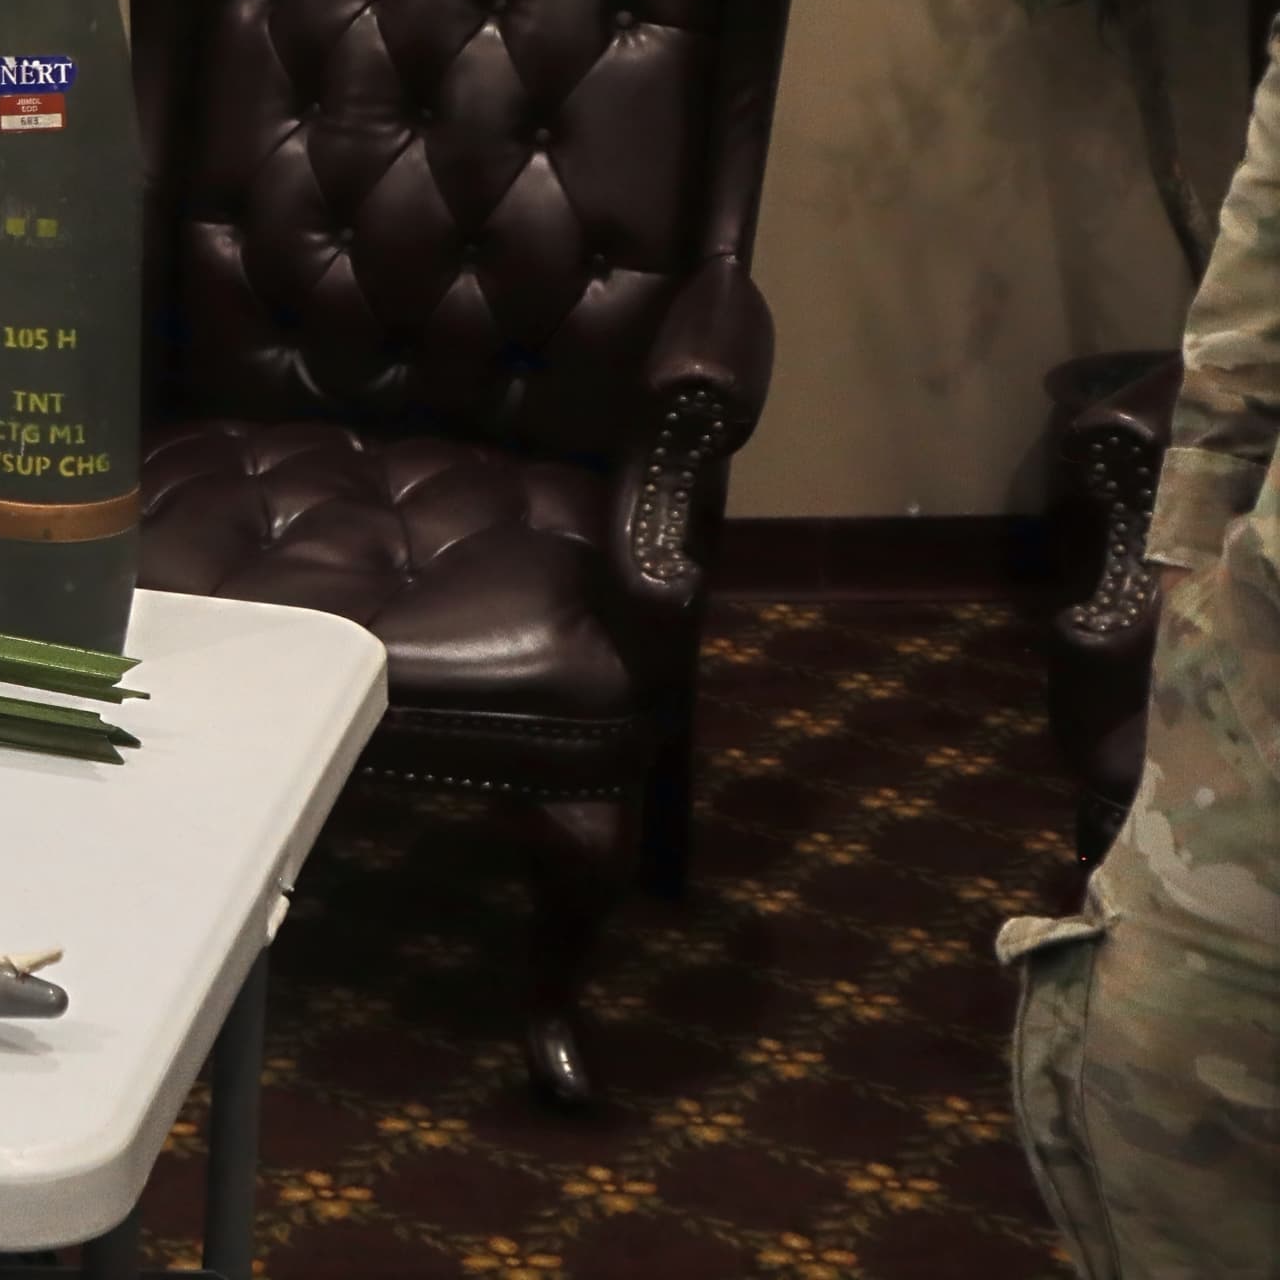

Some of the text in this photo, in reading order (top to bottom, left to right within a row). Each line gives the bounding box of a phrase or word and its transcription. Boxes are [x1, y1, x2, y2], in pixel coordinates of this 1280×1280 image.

[3, 326, 77, 350] 105 H
[13, 390, 65, 414] TNT
[49, 423, 86, 445] M1
